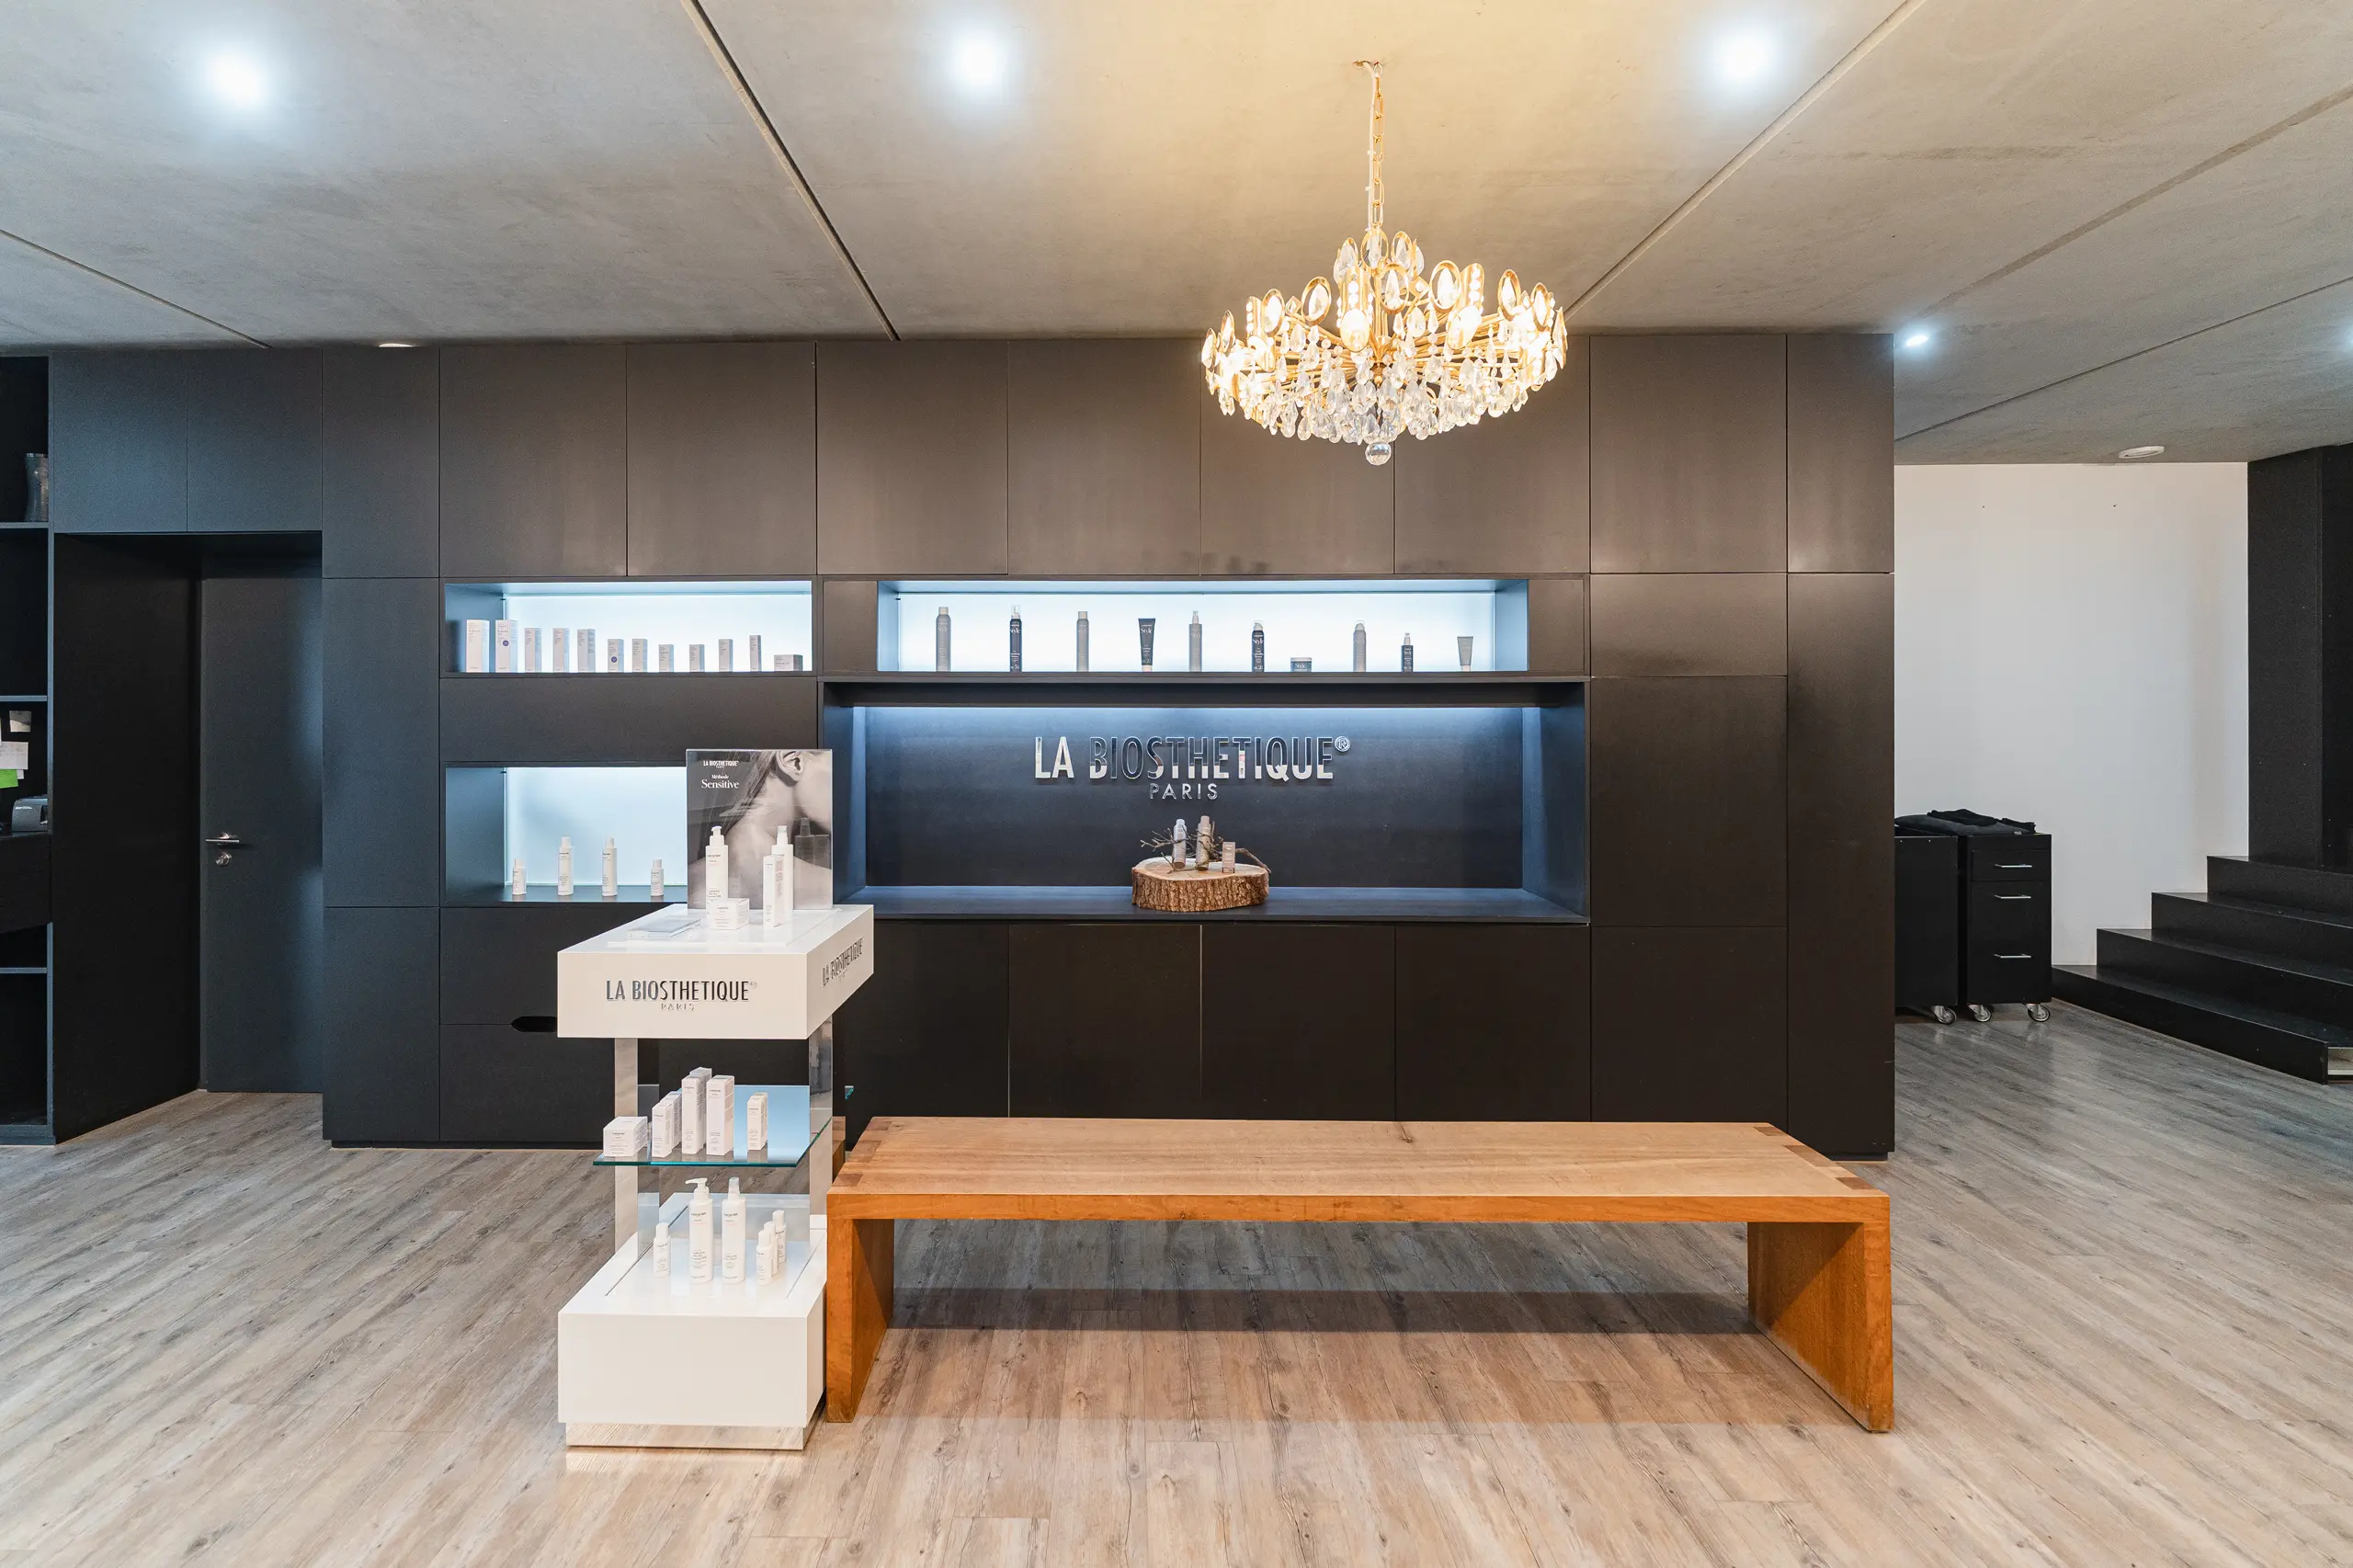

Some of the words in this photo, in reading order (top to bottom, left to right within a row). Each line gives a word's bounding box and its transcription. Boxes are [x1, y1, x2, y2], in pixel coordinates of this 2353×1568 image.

[1035, 736, 1074, 779] LA
[701, 778, 740, 790] Sensitive
[1150, 782, 1218, 800] PARIS
[606, 980, 626, 1000] LA
